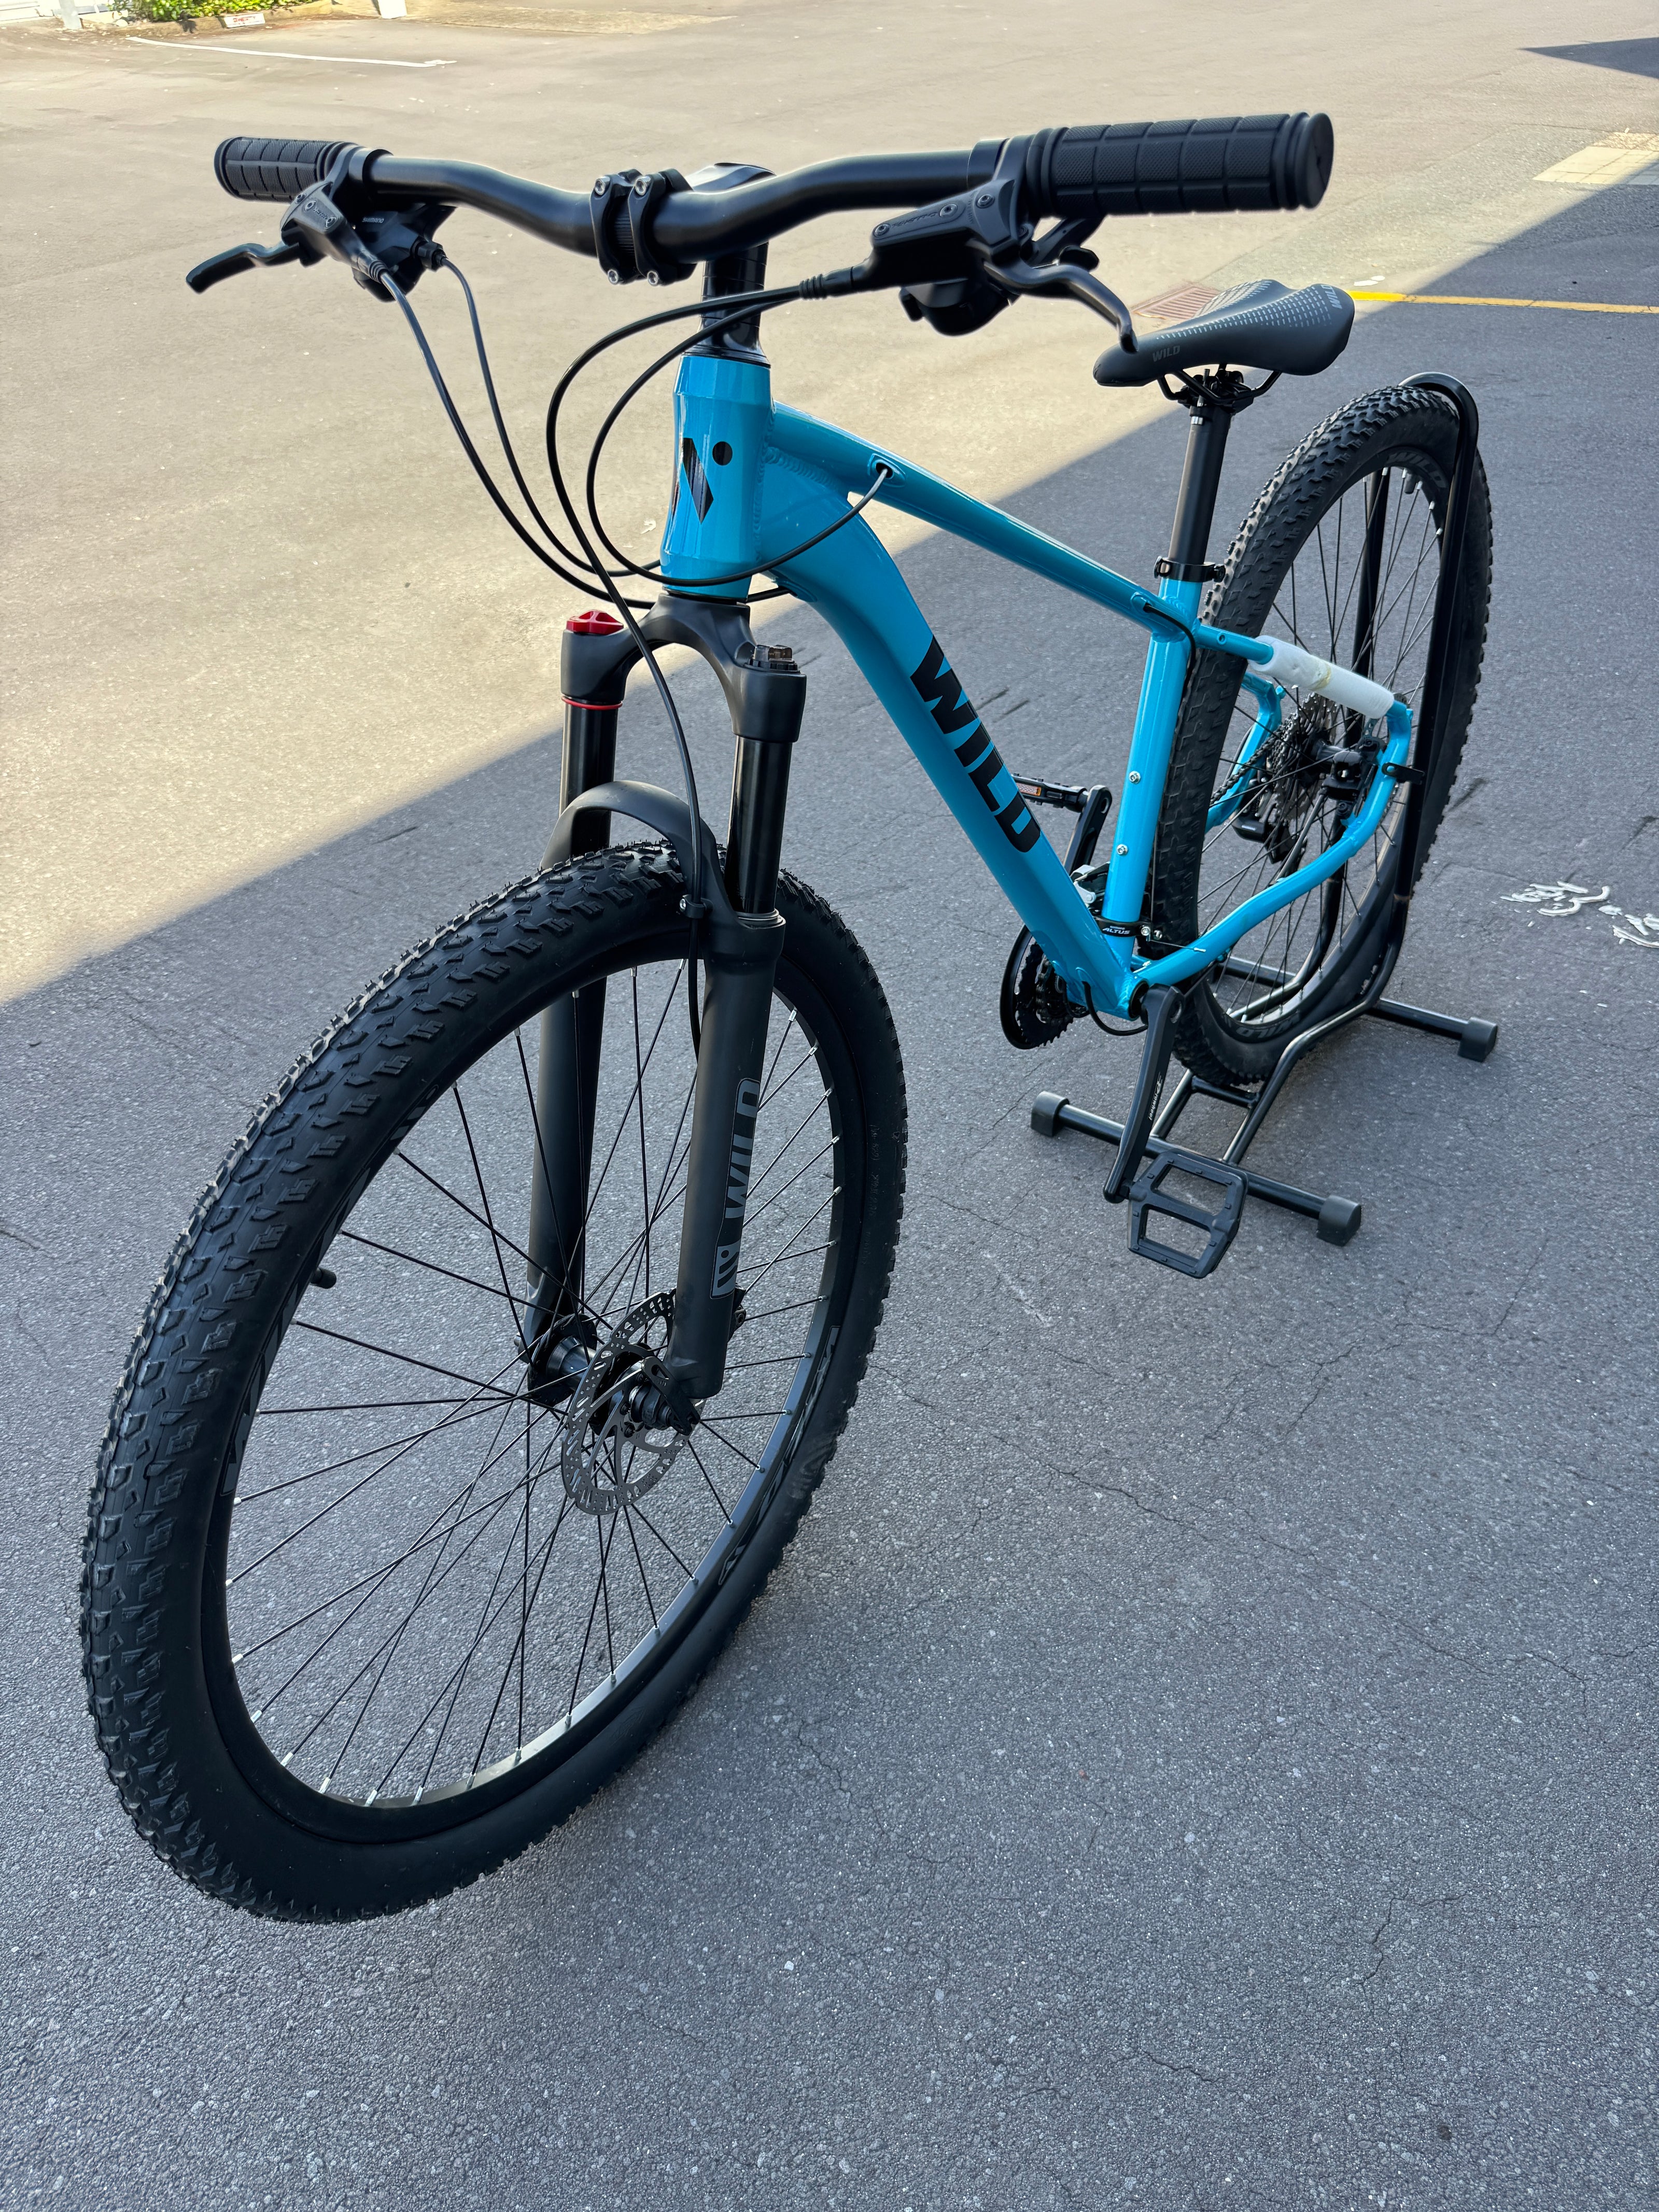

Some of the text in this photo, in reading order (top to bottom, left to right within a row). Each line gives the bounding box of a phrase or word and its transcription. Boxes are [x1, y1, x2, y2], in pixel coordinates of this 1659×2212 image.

[1152, 345, 1180, 362] WILD
[1385, 452, 1447, 488] WILD
[910, 635, 1041, 853] WILD
